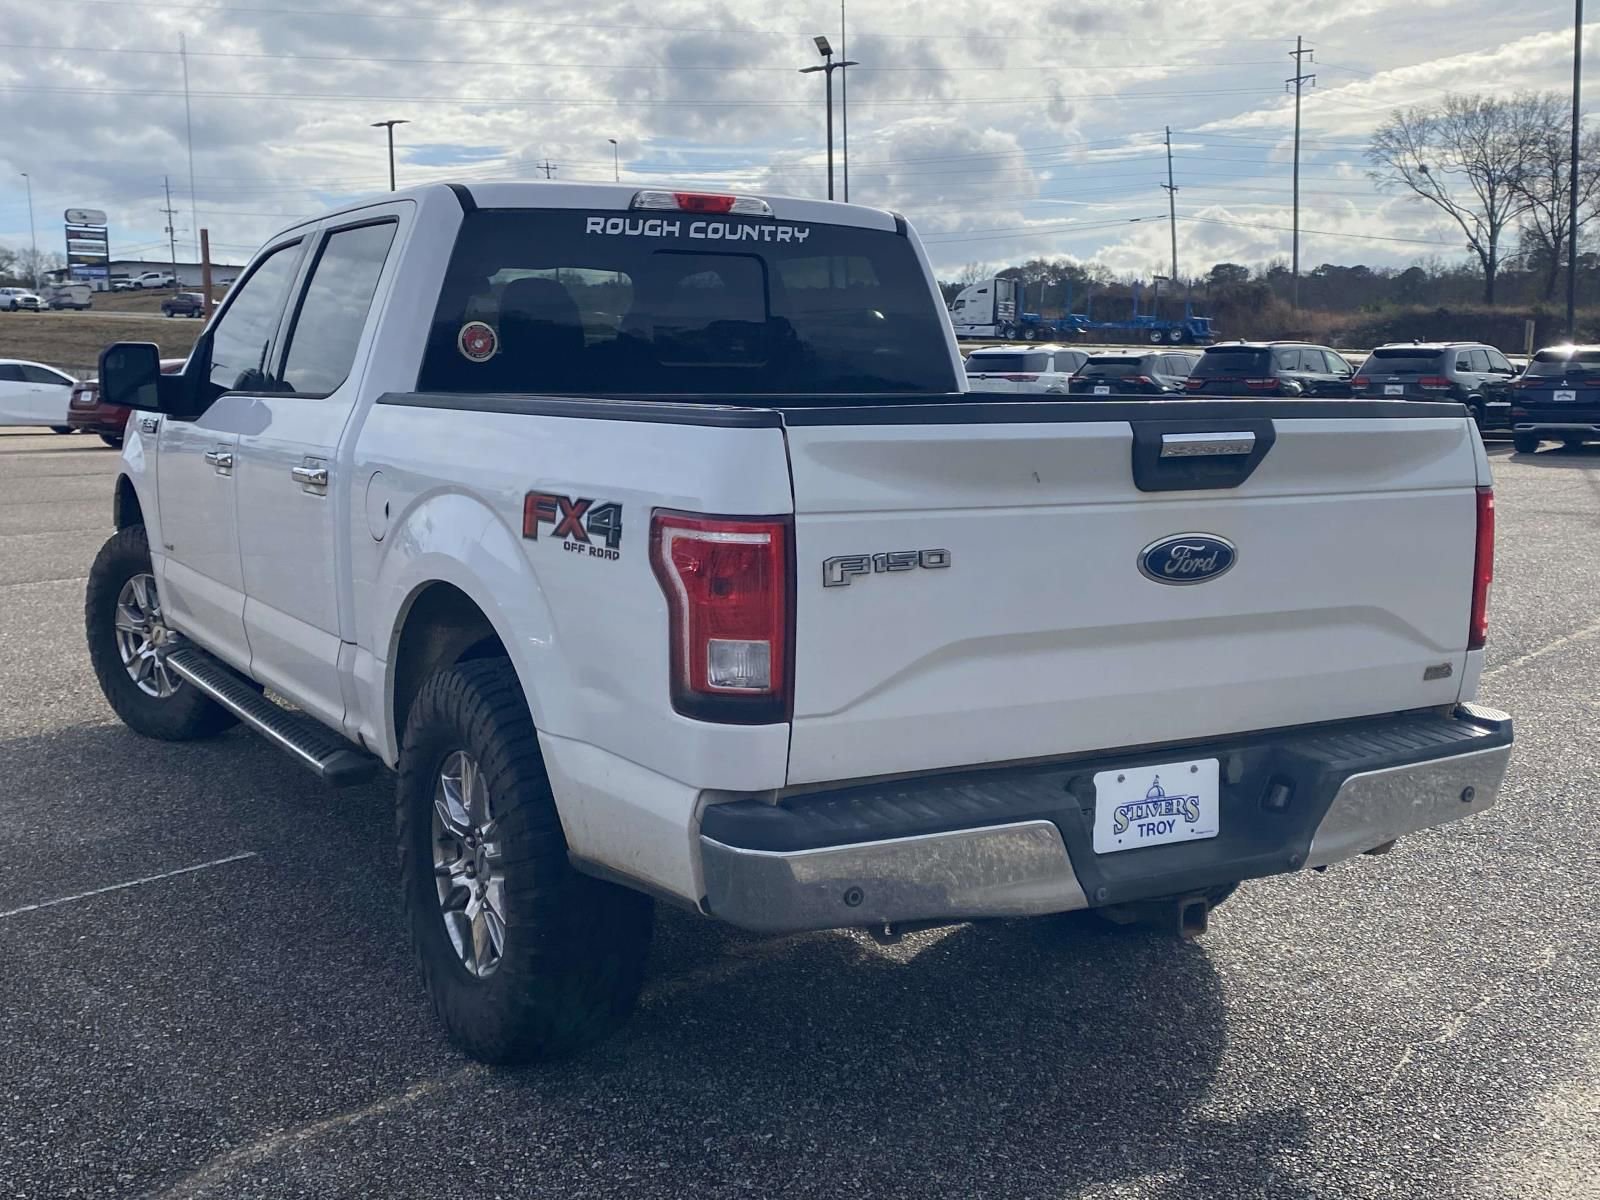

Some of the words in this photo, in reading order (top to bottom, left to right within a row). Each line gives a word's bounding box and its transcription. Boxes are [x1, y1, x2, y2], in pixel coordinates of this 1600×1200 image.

[585, 216, 680, 237] ROUGH
[689, 221, 810, 243] COUNTRY
[522, 490, 623, 550] FX4
[563, 541, 586, 553] OFF
[589, 546, 620, 561] ROAD
[1164, 545, 1219, 574] Ford
[1113, 795, 1200, 835] STIVERS
[1137, 819, 1176, 837] TROY
